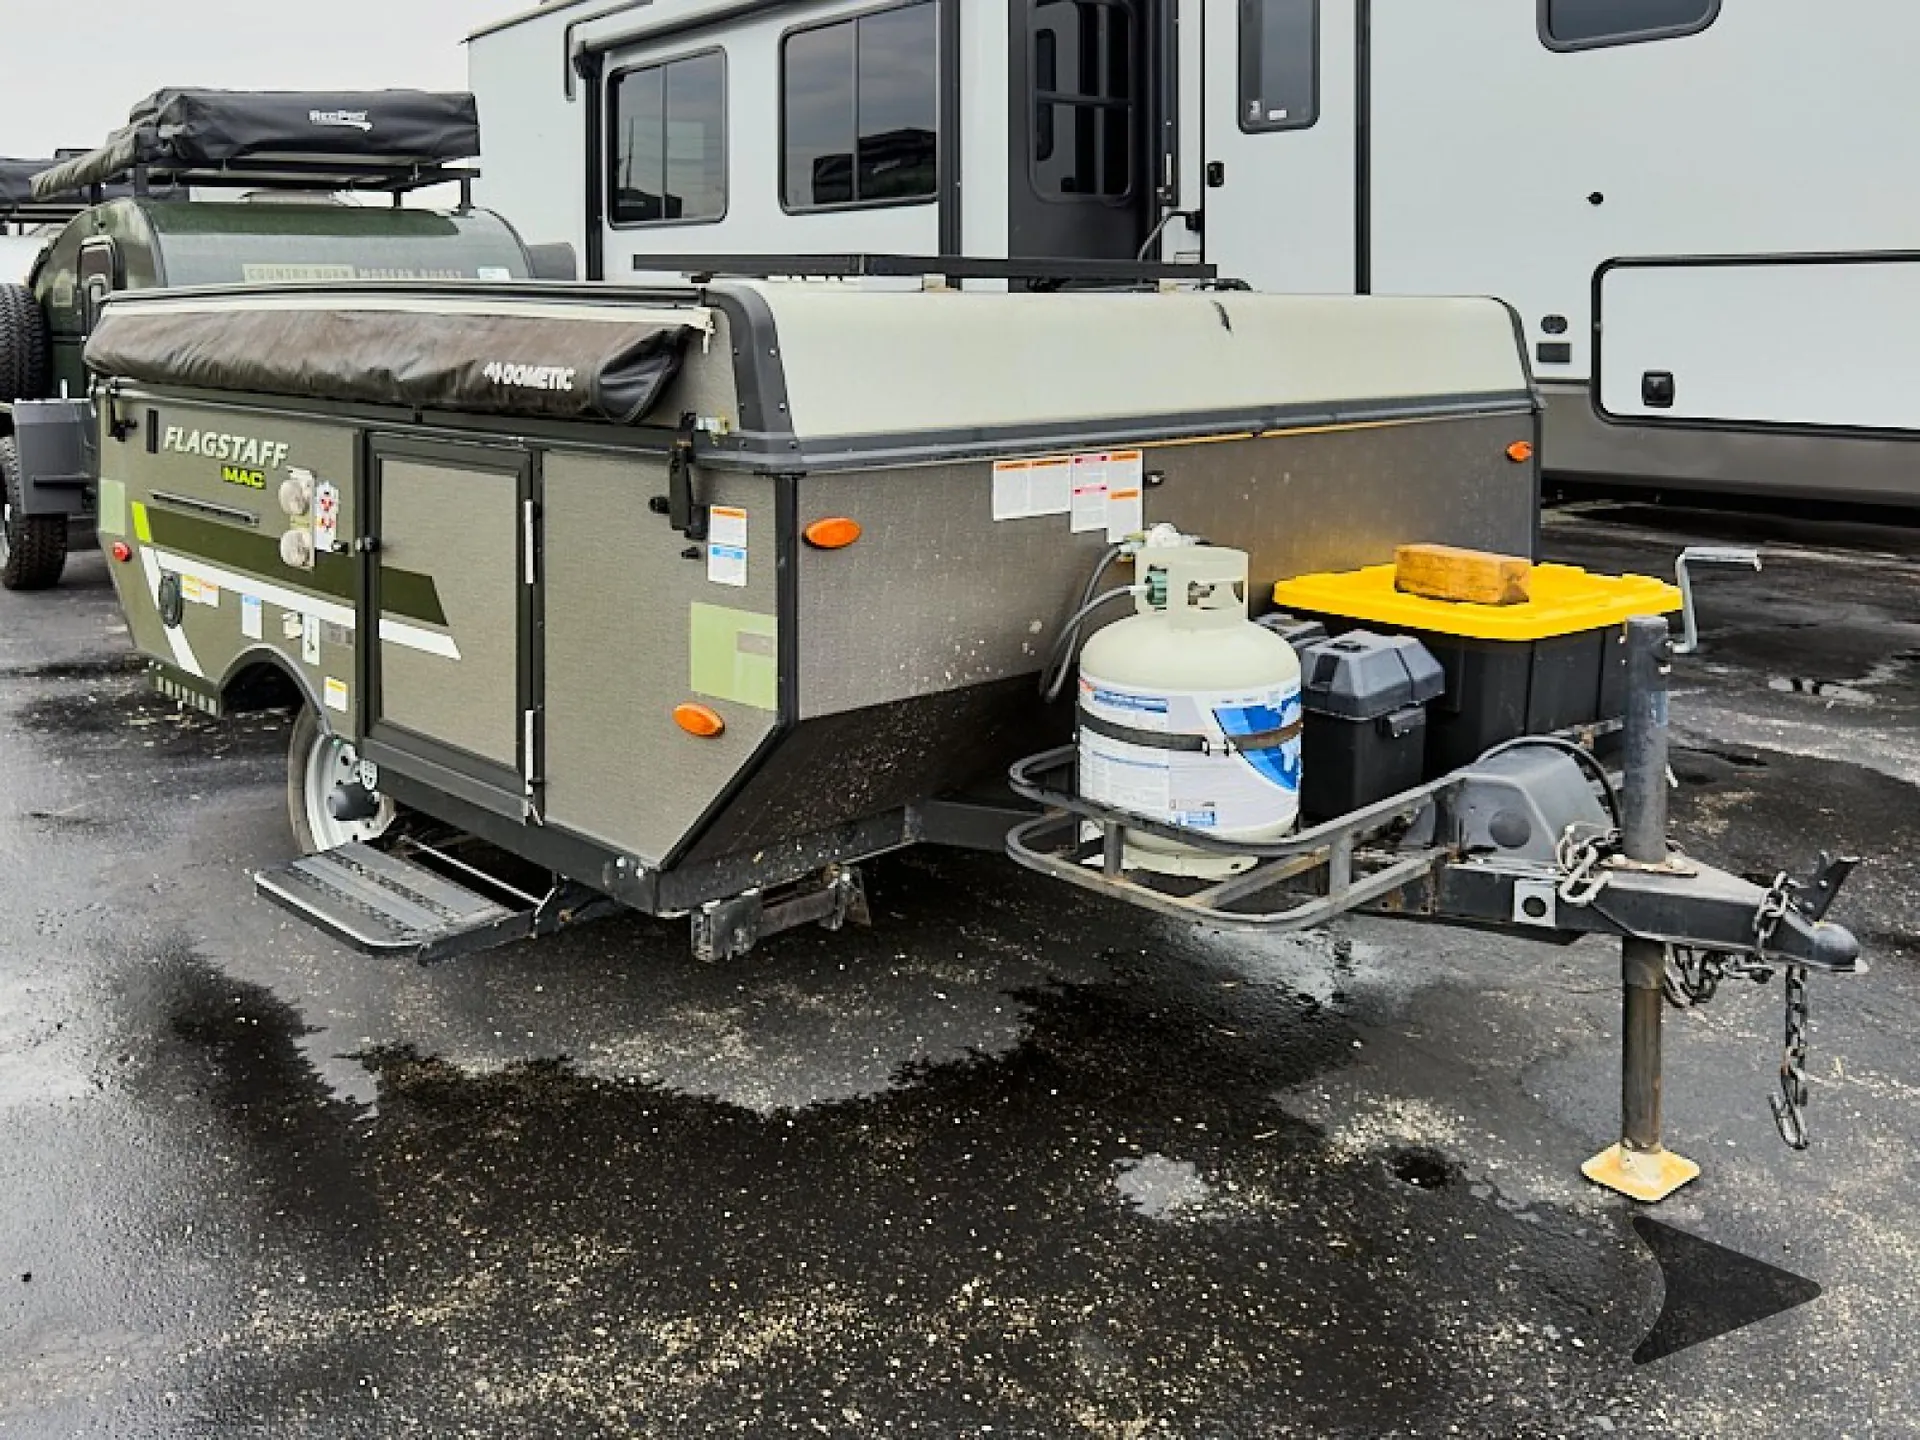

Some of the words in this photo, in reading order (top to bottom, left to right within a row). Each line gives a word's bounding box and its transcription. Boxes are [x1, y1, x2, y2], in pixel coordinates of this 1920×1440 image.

[503, 364, 576, 391] DOMETIC
[162, 424, 289, 469] FLAGSTAFF
[222, 466, 265, 489] MAC
